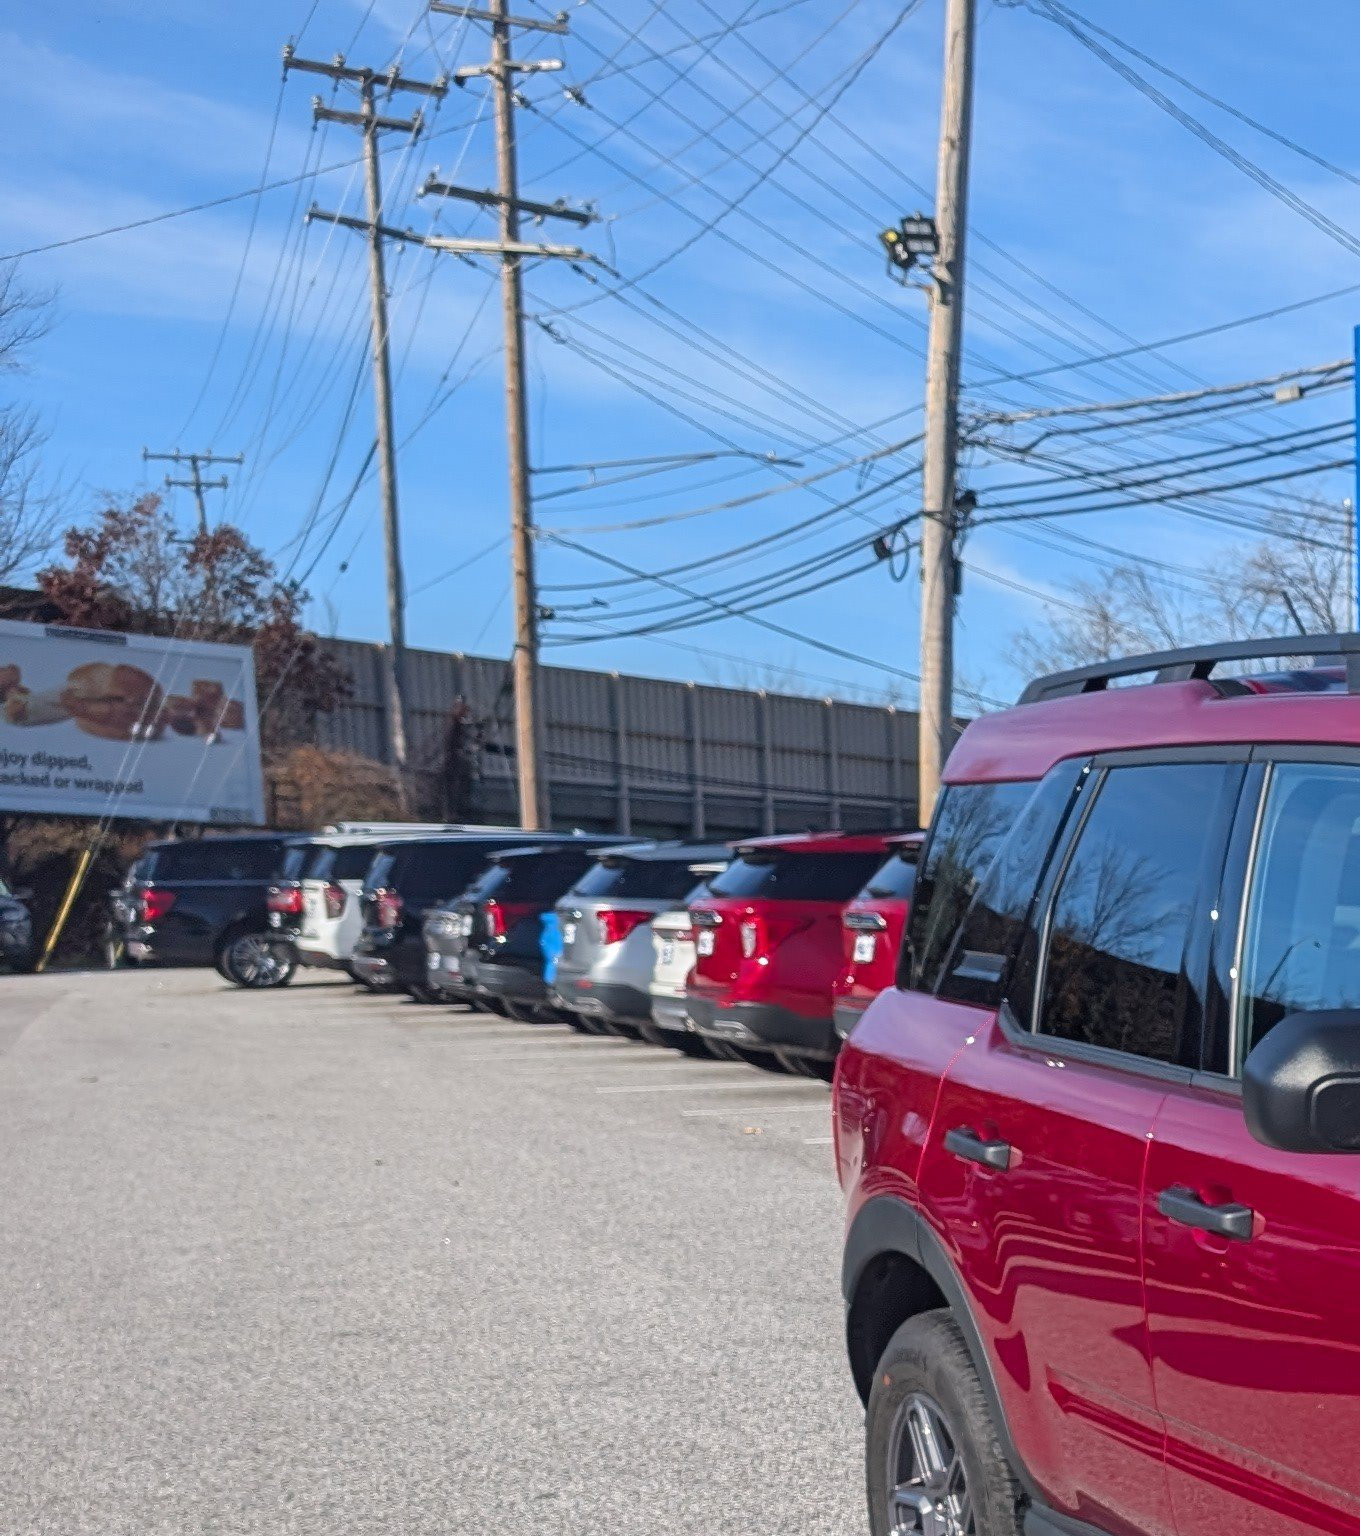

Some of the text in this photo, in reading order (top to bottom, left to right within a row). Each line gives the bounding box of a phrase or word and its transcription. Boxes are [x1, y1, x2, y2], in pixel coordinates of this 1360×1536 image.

[32, 751, 93, 770] dipped,
[53, 776, 70, 789] or
[74, 778, 144, 794] wrapped
